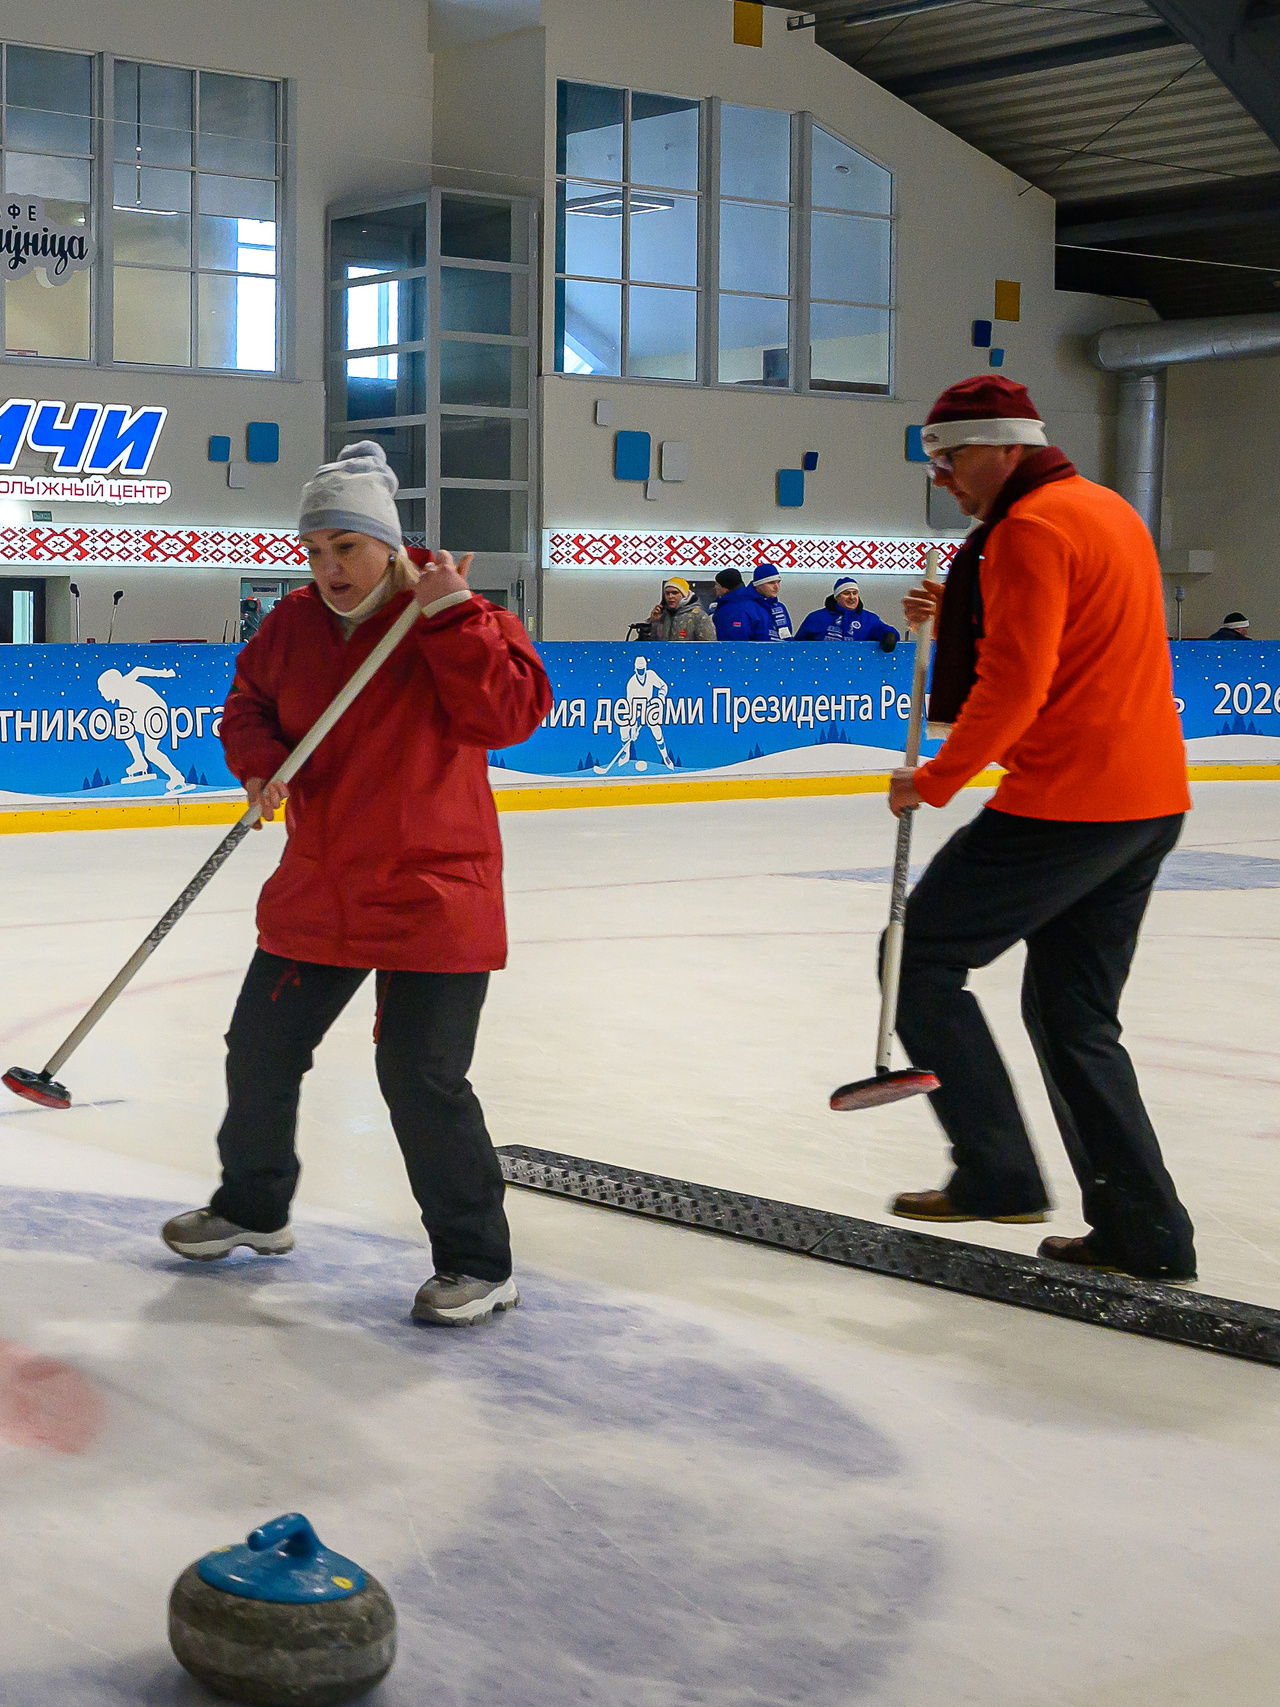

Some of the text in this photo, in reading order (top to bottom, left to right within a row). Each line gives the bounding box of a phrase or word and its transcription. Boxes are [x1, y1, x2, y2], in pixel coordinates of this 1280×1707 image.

[109, 484, 168, 501] ЦЕНТР
[593, 694, 704, 735] делами
[711, 686, 872, 733] Президента
